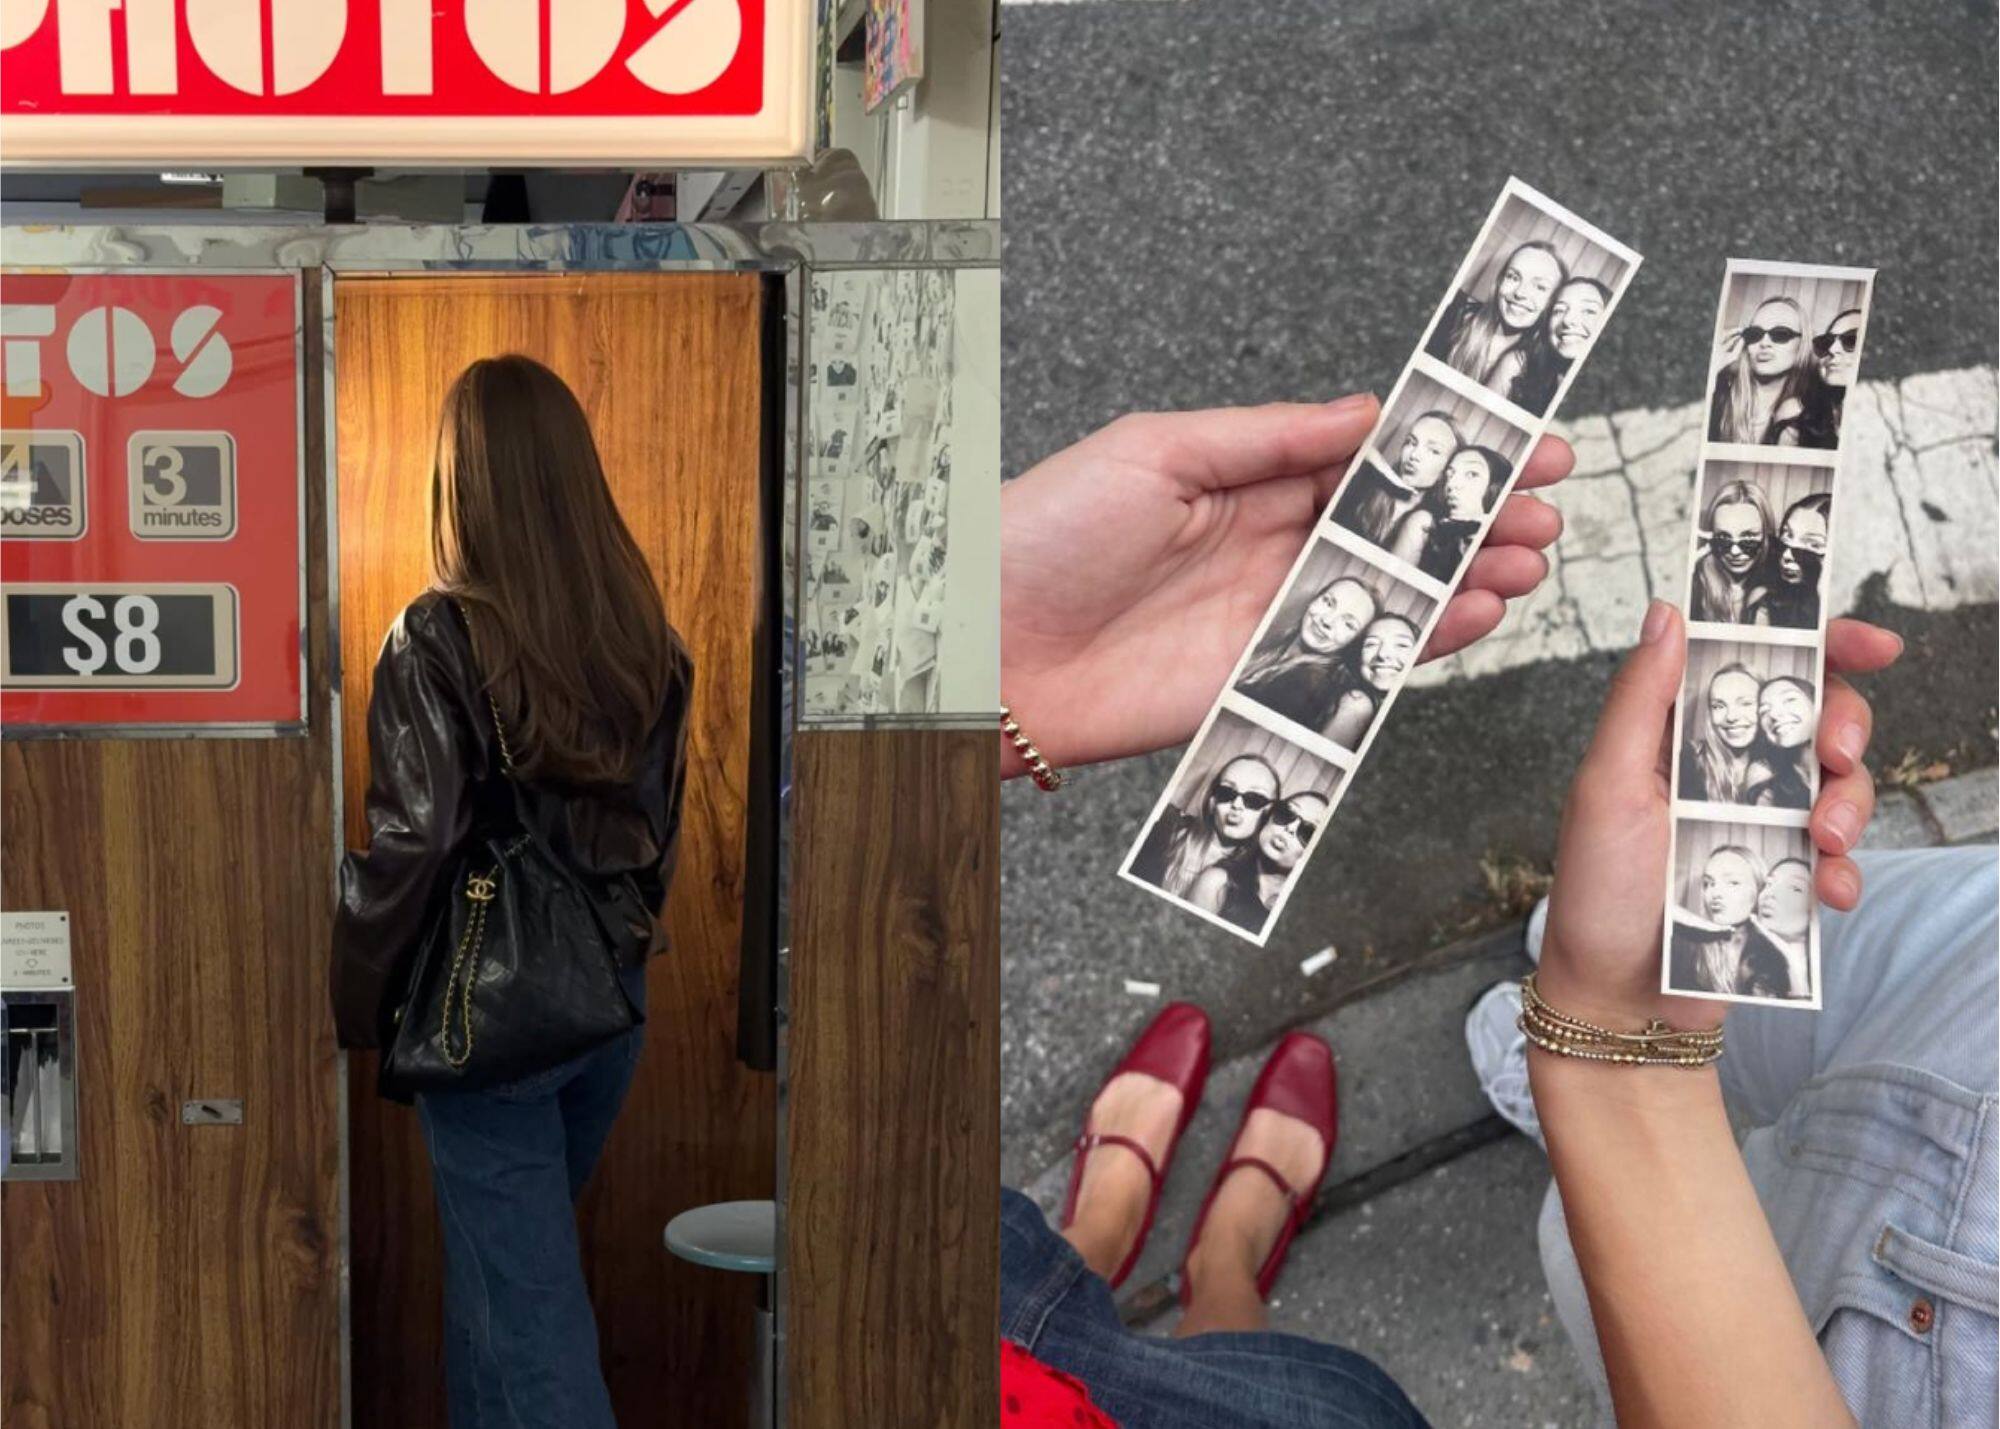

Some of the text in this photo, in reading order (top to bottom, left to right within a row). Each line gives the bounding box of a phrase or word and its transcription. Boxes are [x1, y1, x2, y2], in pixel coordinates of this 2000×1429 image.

[144, 446, 187, 506] 3
[144, 510, 222, 527] minutes
[62, 593, 161, 676] $8
